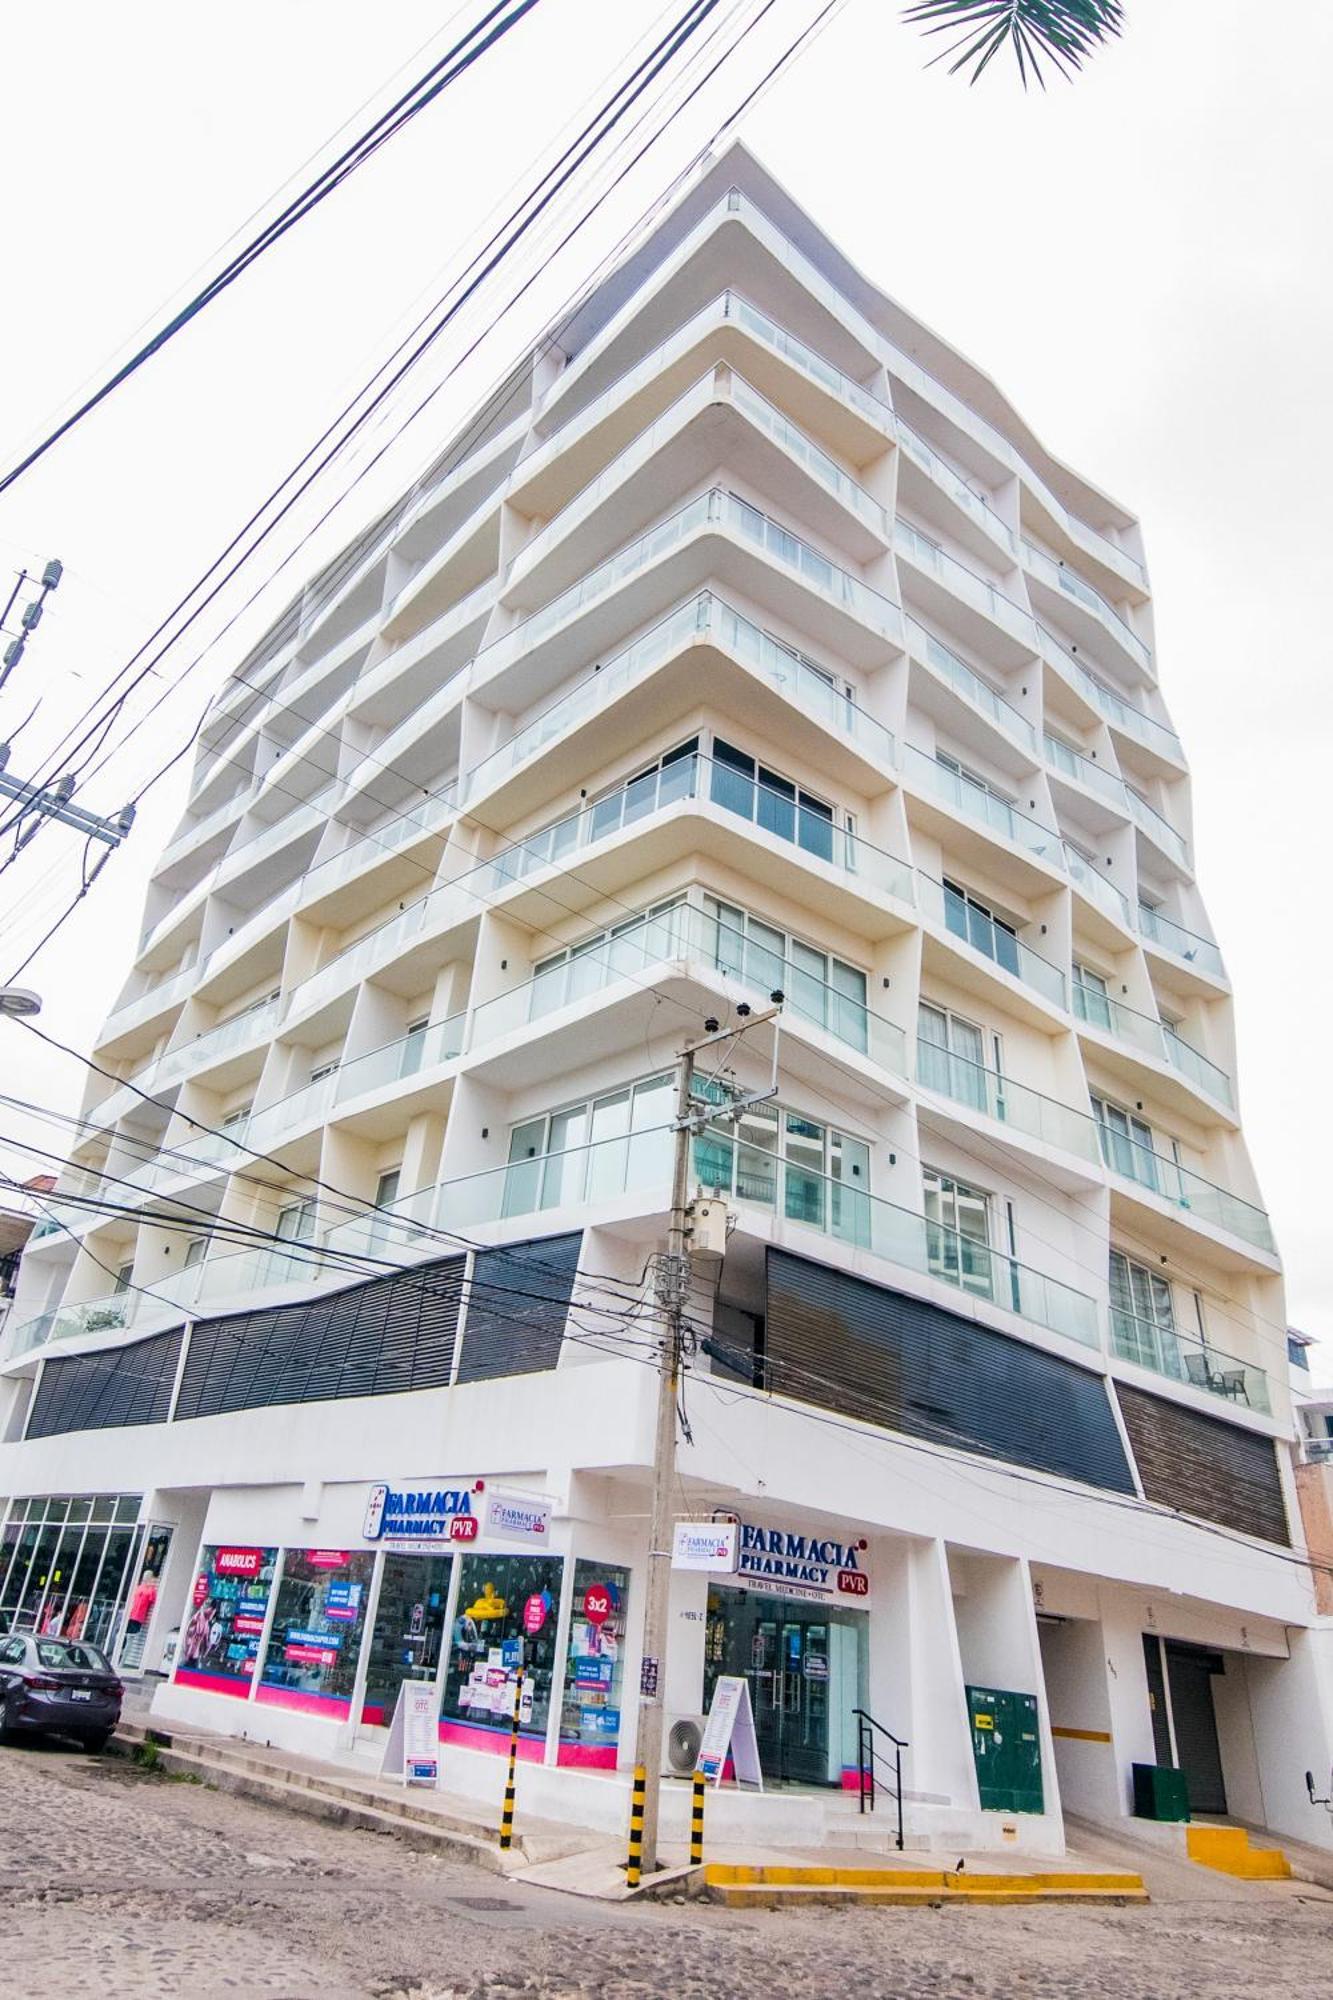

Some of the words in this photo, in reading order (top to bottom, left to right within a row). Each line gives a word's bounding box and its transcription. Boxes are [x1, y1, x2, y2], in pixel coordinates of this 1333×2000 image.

[387, 1491, 471, 1516] FARMACIA
[501, 1509, 541, 1523] FARMACIA
[383, 1519, 446, 1535] PHARMACY
[451, 1521, 474, 1537] PVR
[740, 1524, 858, 1570] FARMACIA
[219, 1553, 257, 1569] ANABOLICS
[740, 1554, 829, 1584] PHARMACY
[841, 1576, 866, 1593] PVR
[587, 1596, 608, 1613] 3x2
